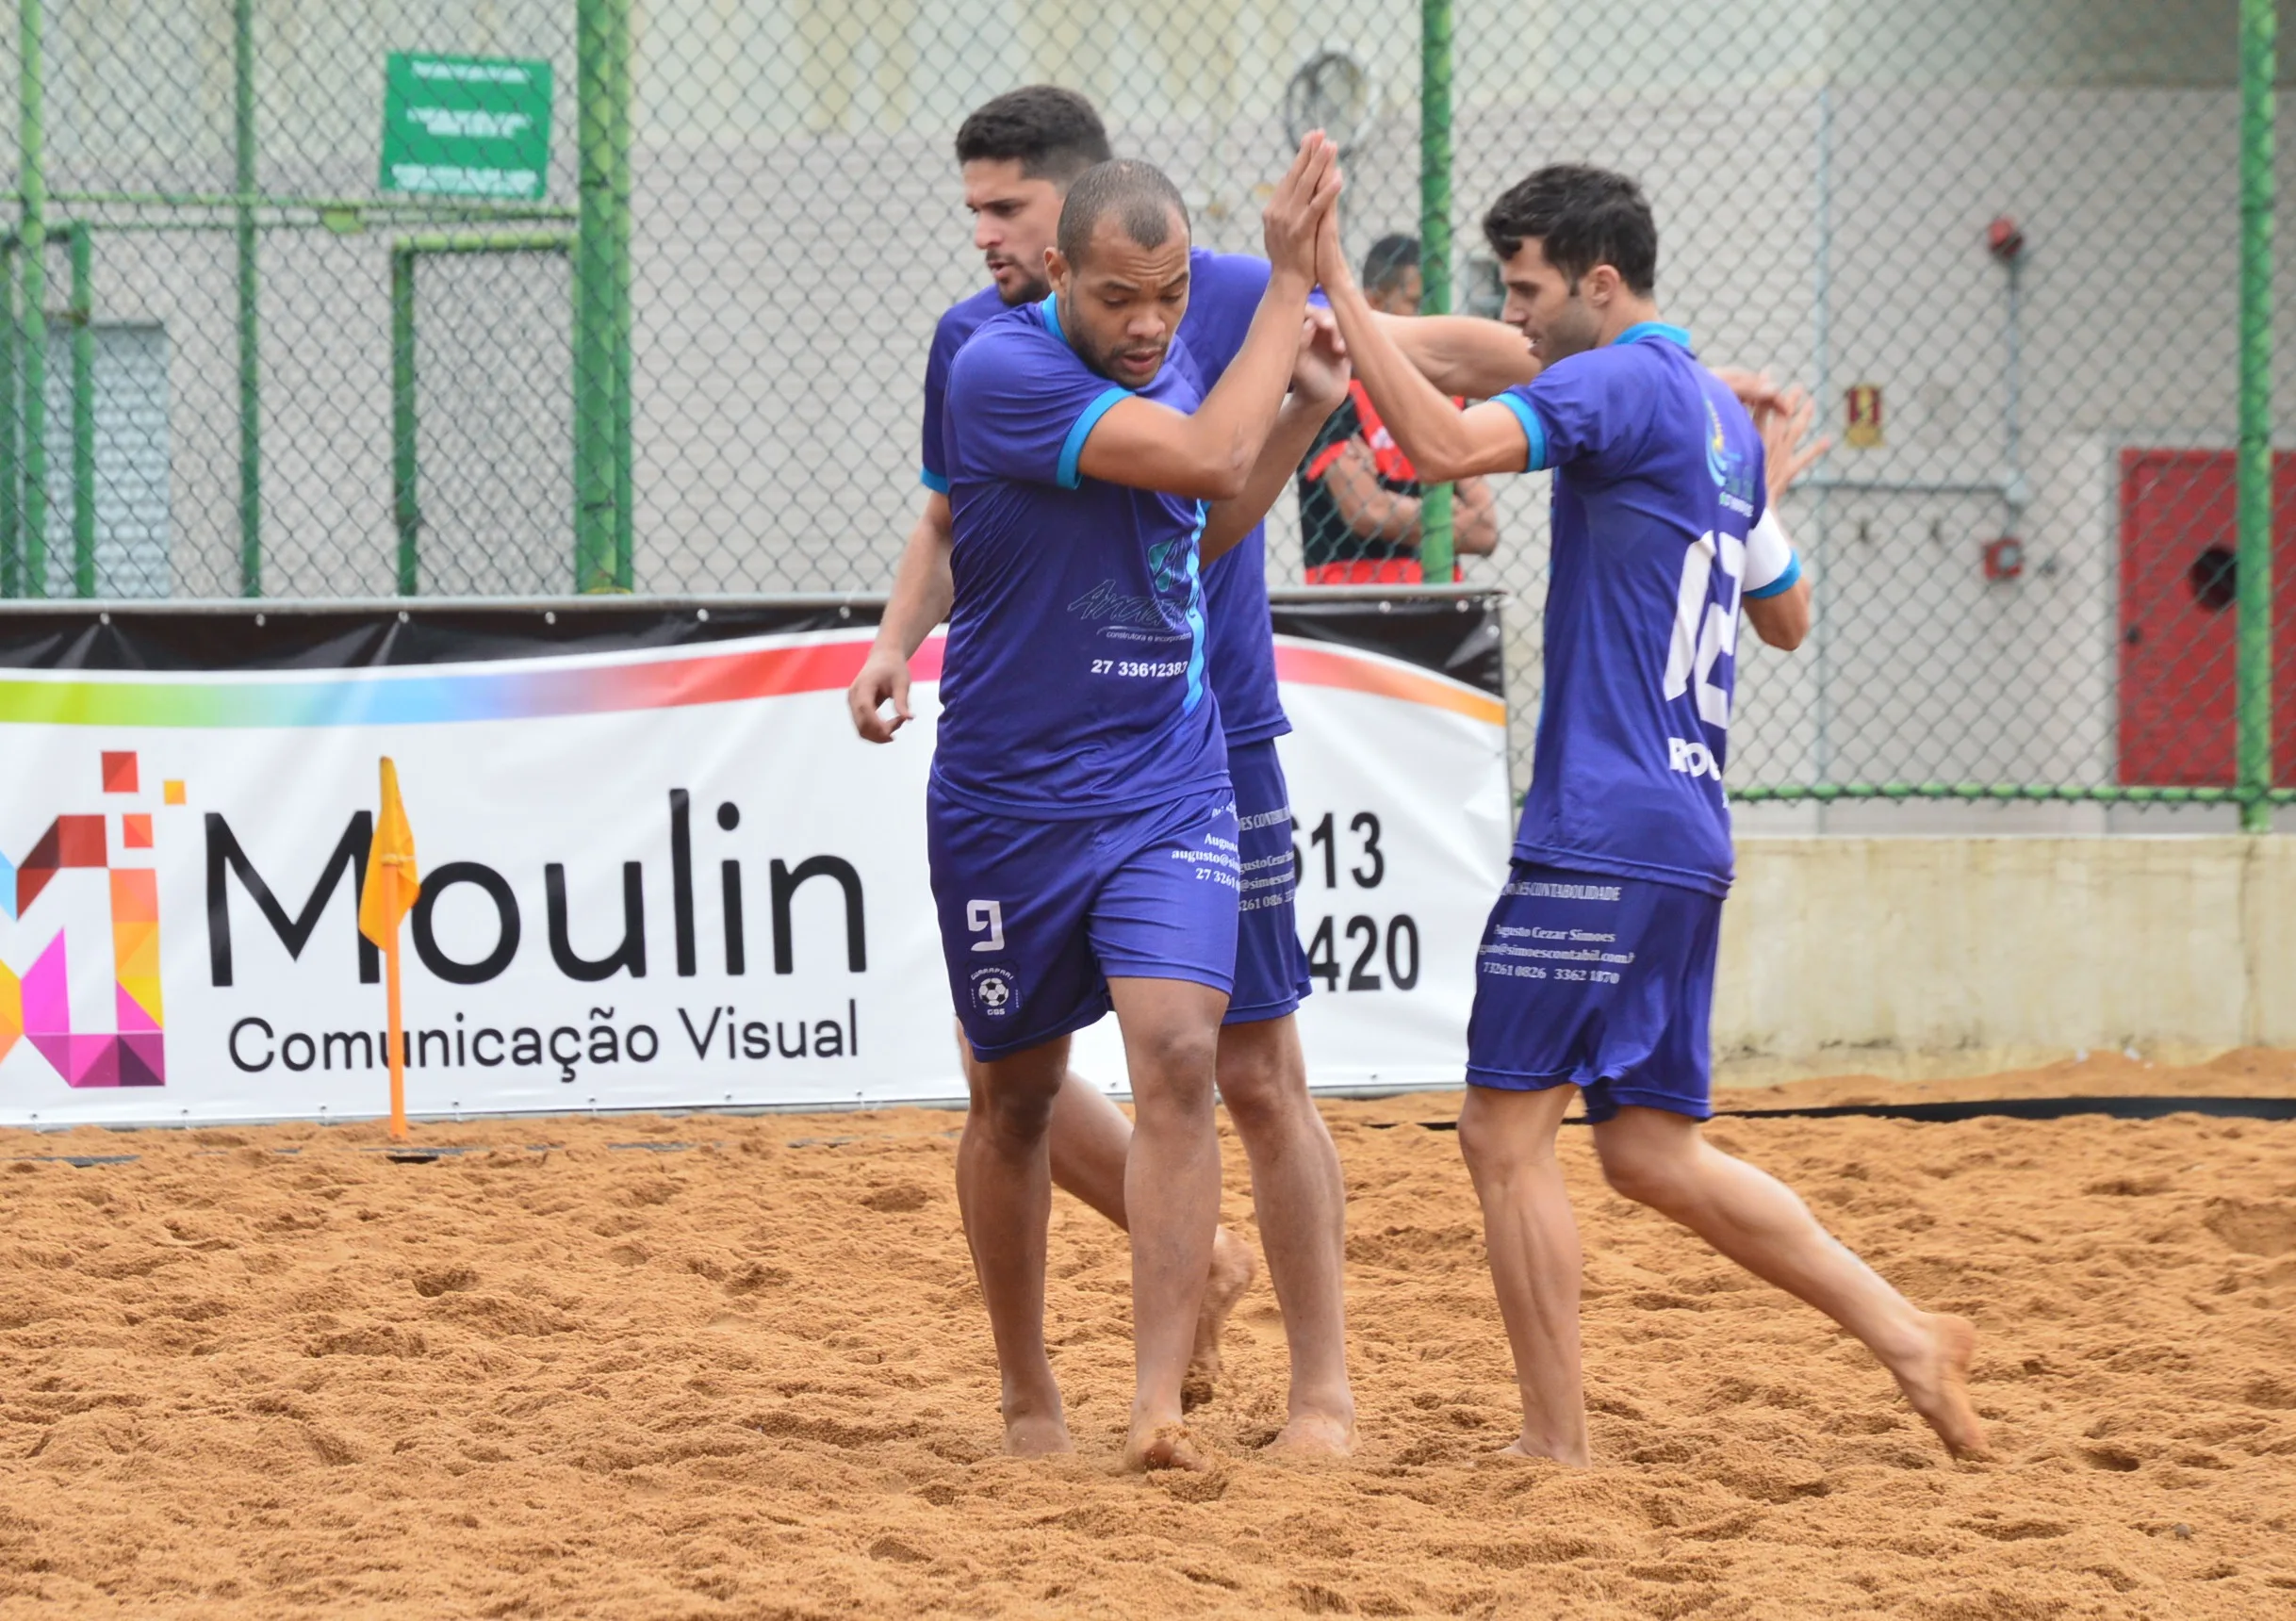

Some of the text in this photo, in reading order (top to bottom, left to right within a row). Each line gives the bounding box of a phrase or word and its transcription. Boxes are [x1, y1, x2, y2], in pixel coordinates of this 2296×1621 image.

[1663, 530, 1745, 729] 12
[1091, 660, 1114, 675] 27
[204, 788, 867, 987] Moulin
[1195, 867, 1211, 880] 27
[966, 899, 1005, 952] 9
[1553, 968, 1587, 981] 3362
[227, 998, 860, 1084] Comunicação Visual
